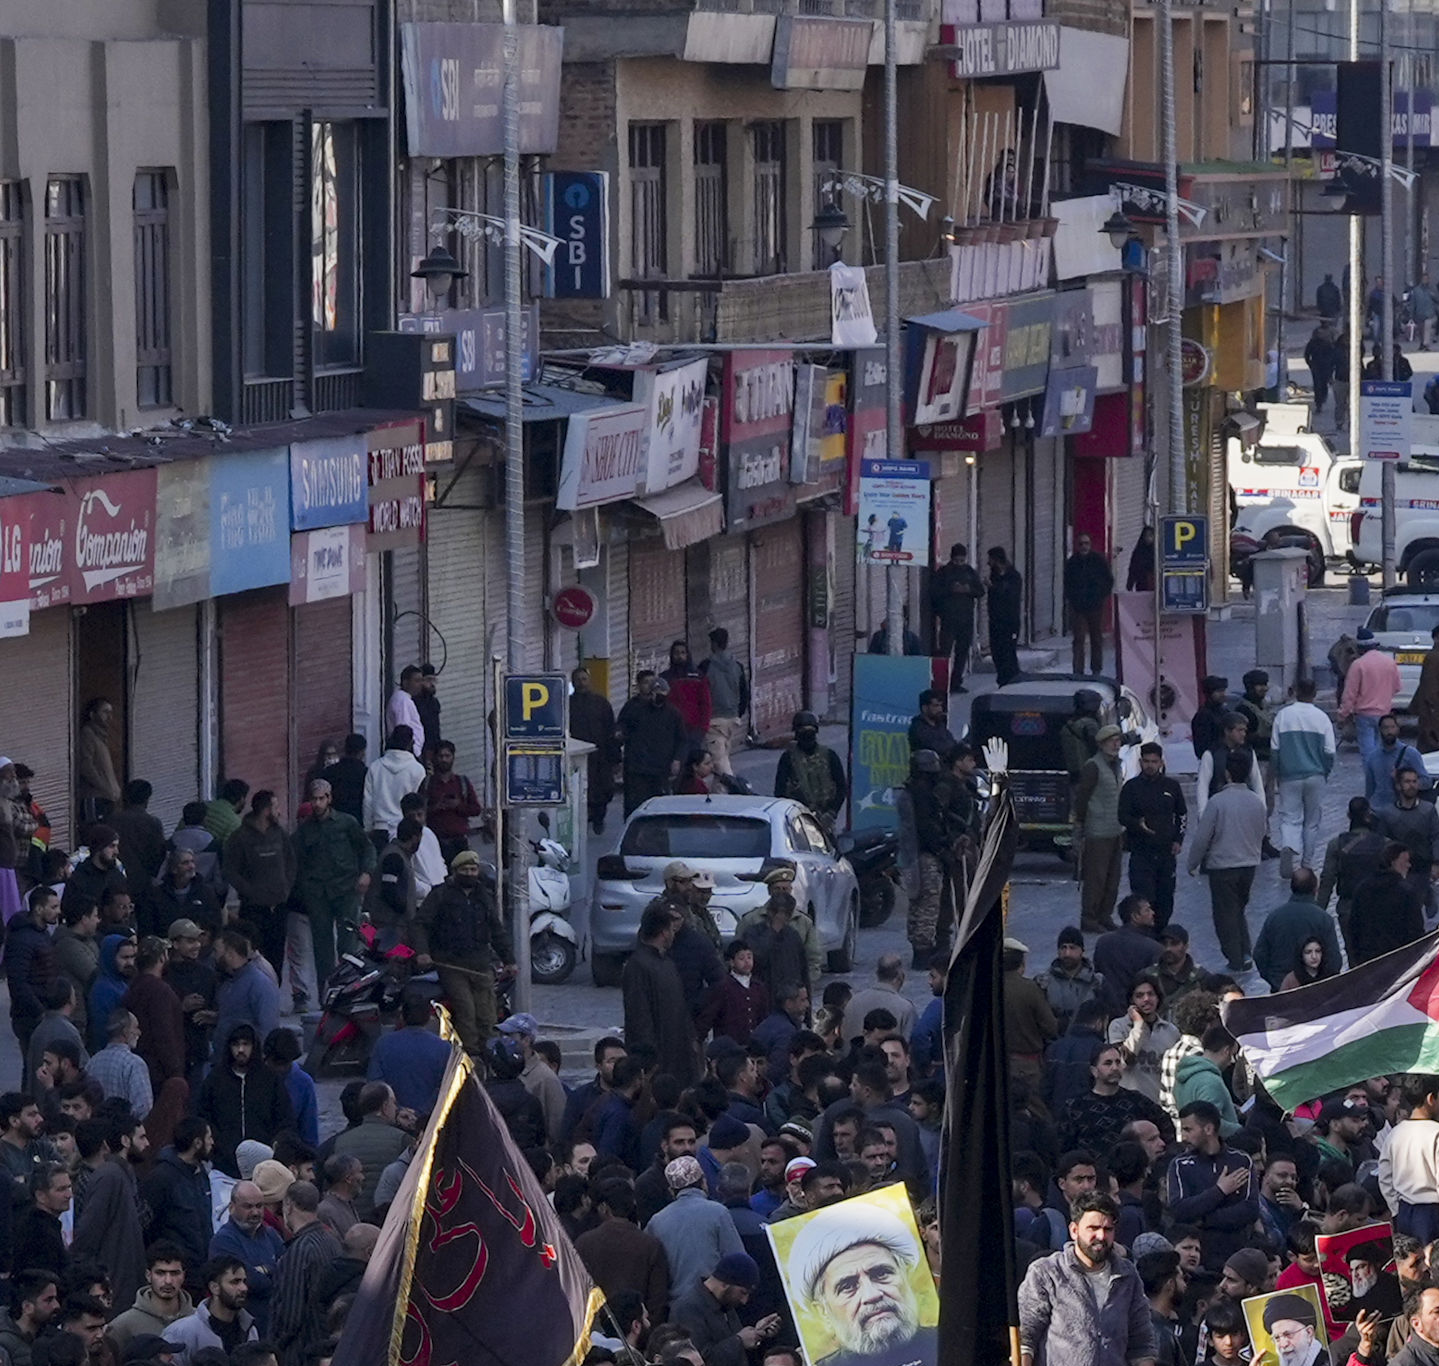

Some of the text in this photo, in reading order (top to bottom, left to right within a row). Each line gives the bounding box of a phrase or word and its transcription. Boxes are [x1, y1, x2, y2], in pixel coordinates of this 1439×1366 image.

[959, 24, 1058, 74] HOTEL DIAMOND
[441, 59, 459, 121] SBI
[1391, 112, 1431, 136] KASMIR
[567, 215, 586, 290] SBI
[302, 454, 361, 510] SAMSUNG
[5, 525, 22, 573] LG
[75, 490, 147, 570] Companion
[1174, 521, 1197, 551] P
[522, 683, 549, 720] P
